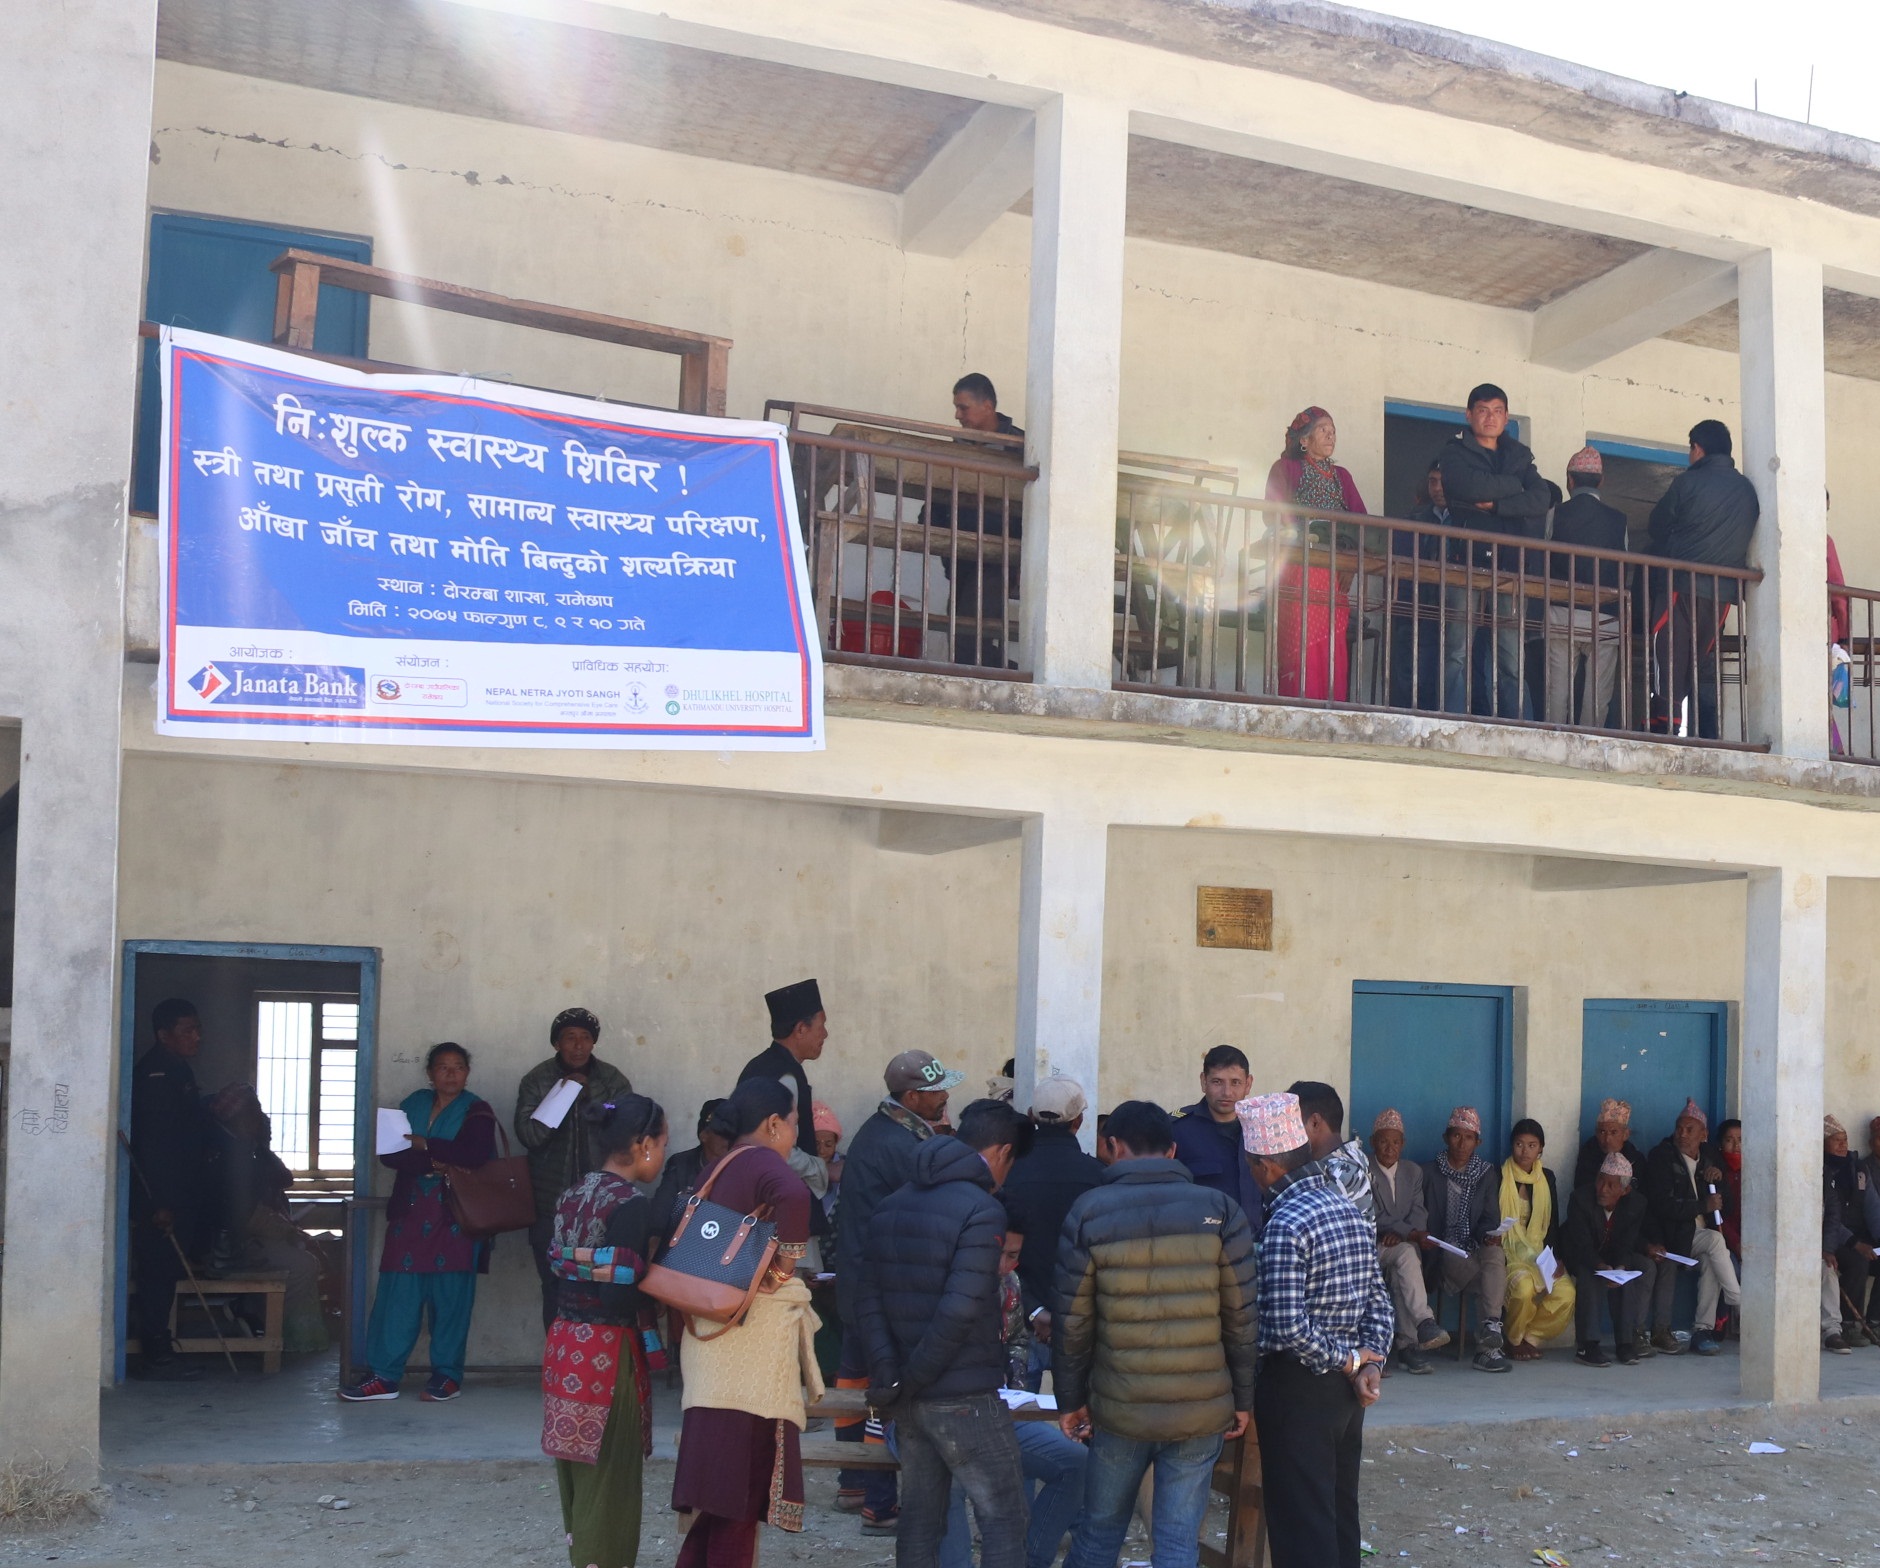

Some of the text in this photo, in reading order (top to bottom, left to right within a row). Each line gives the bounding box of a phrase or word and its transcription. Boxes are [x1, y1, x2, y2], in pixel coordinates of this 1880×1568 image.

[426, 428, 549, 474] स्वास्थ्य
[561, 439, 661, 493] शिविर
[192, 446, 766, 543] स्त्री तथा प्रसूती रोग, सामान्य स्वास्थ्य परिक्षण,
[238, 501, 737, 579] आँखा जाँच तथा मोति बिन्दुको शल्यक्रिया
[442, 580, 499, 602] दोरम्बा
[504, 589, 549, 607] शाखा,
[554, 590, 614, 608] रामेछाप
[462, 611, 527, 629] फाल्गुण
[571, 616, 584, 629] र
[589, 618, 613, 630] १०
[616, 616, 646, 631] गते
[231, 669, 358, 697] Janata Bank
[485, 688, 620, 699] NEPAL NETRA JYOTI SANGH
[683, 690, 739, 701] DHULIKHEL
[745, 690, 792, 703] HOSPITAL
[683, 703, 792, 713] KATHMANDU UNIVERSITY HOSPITAL
